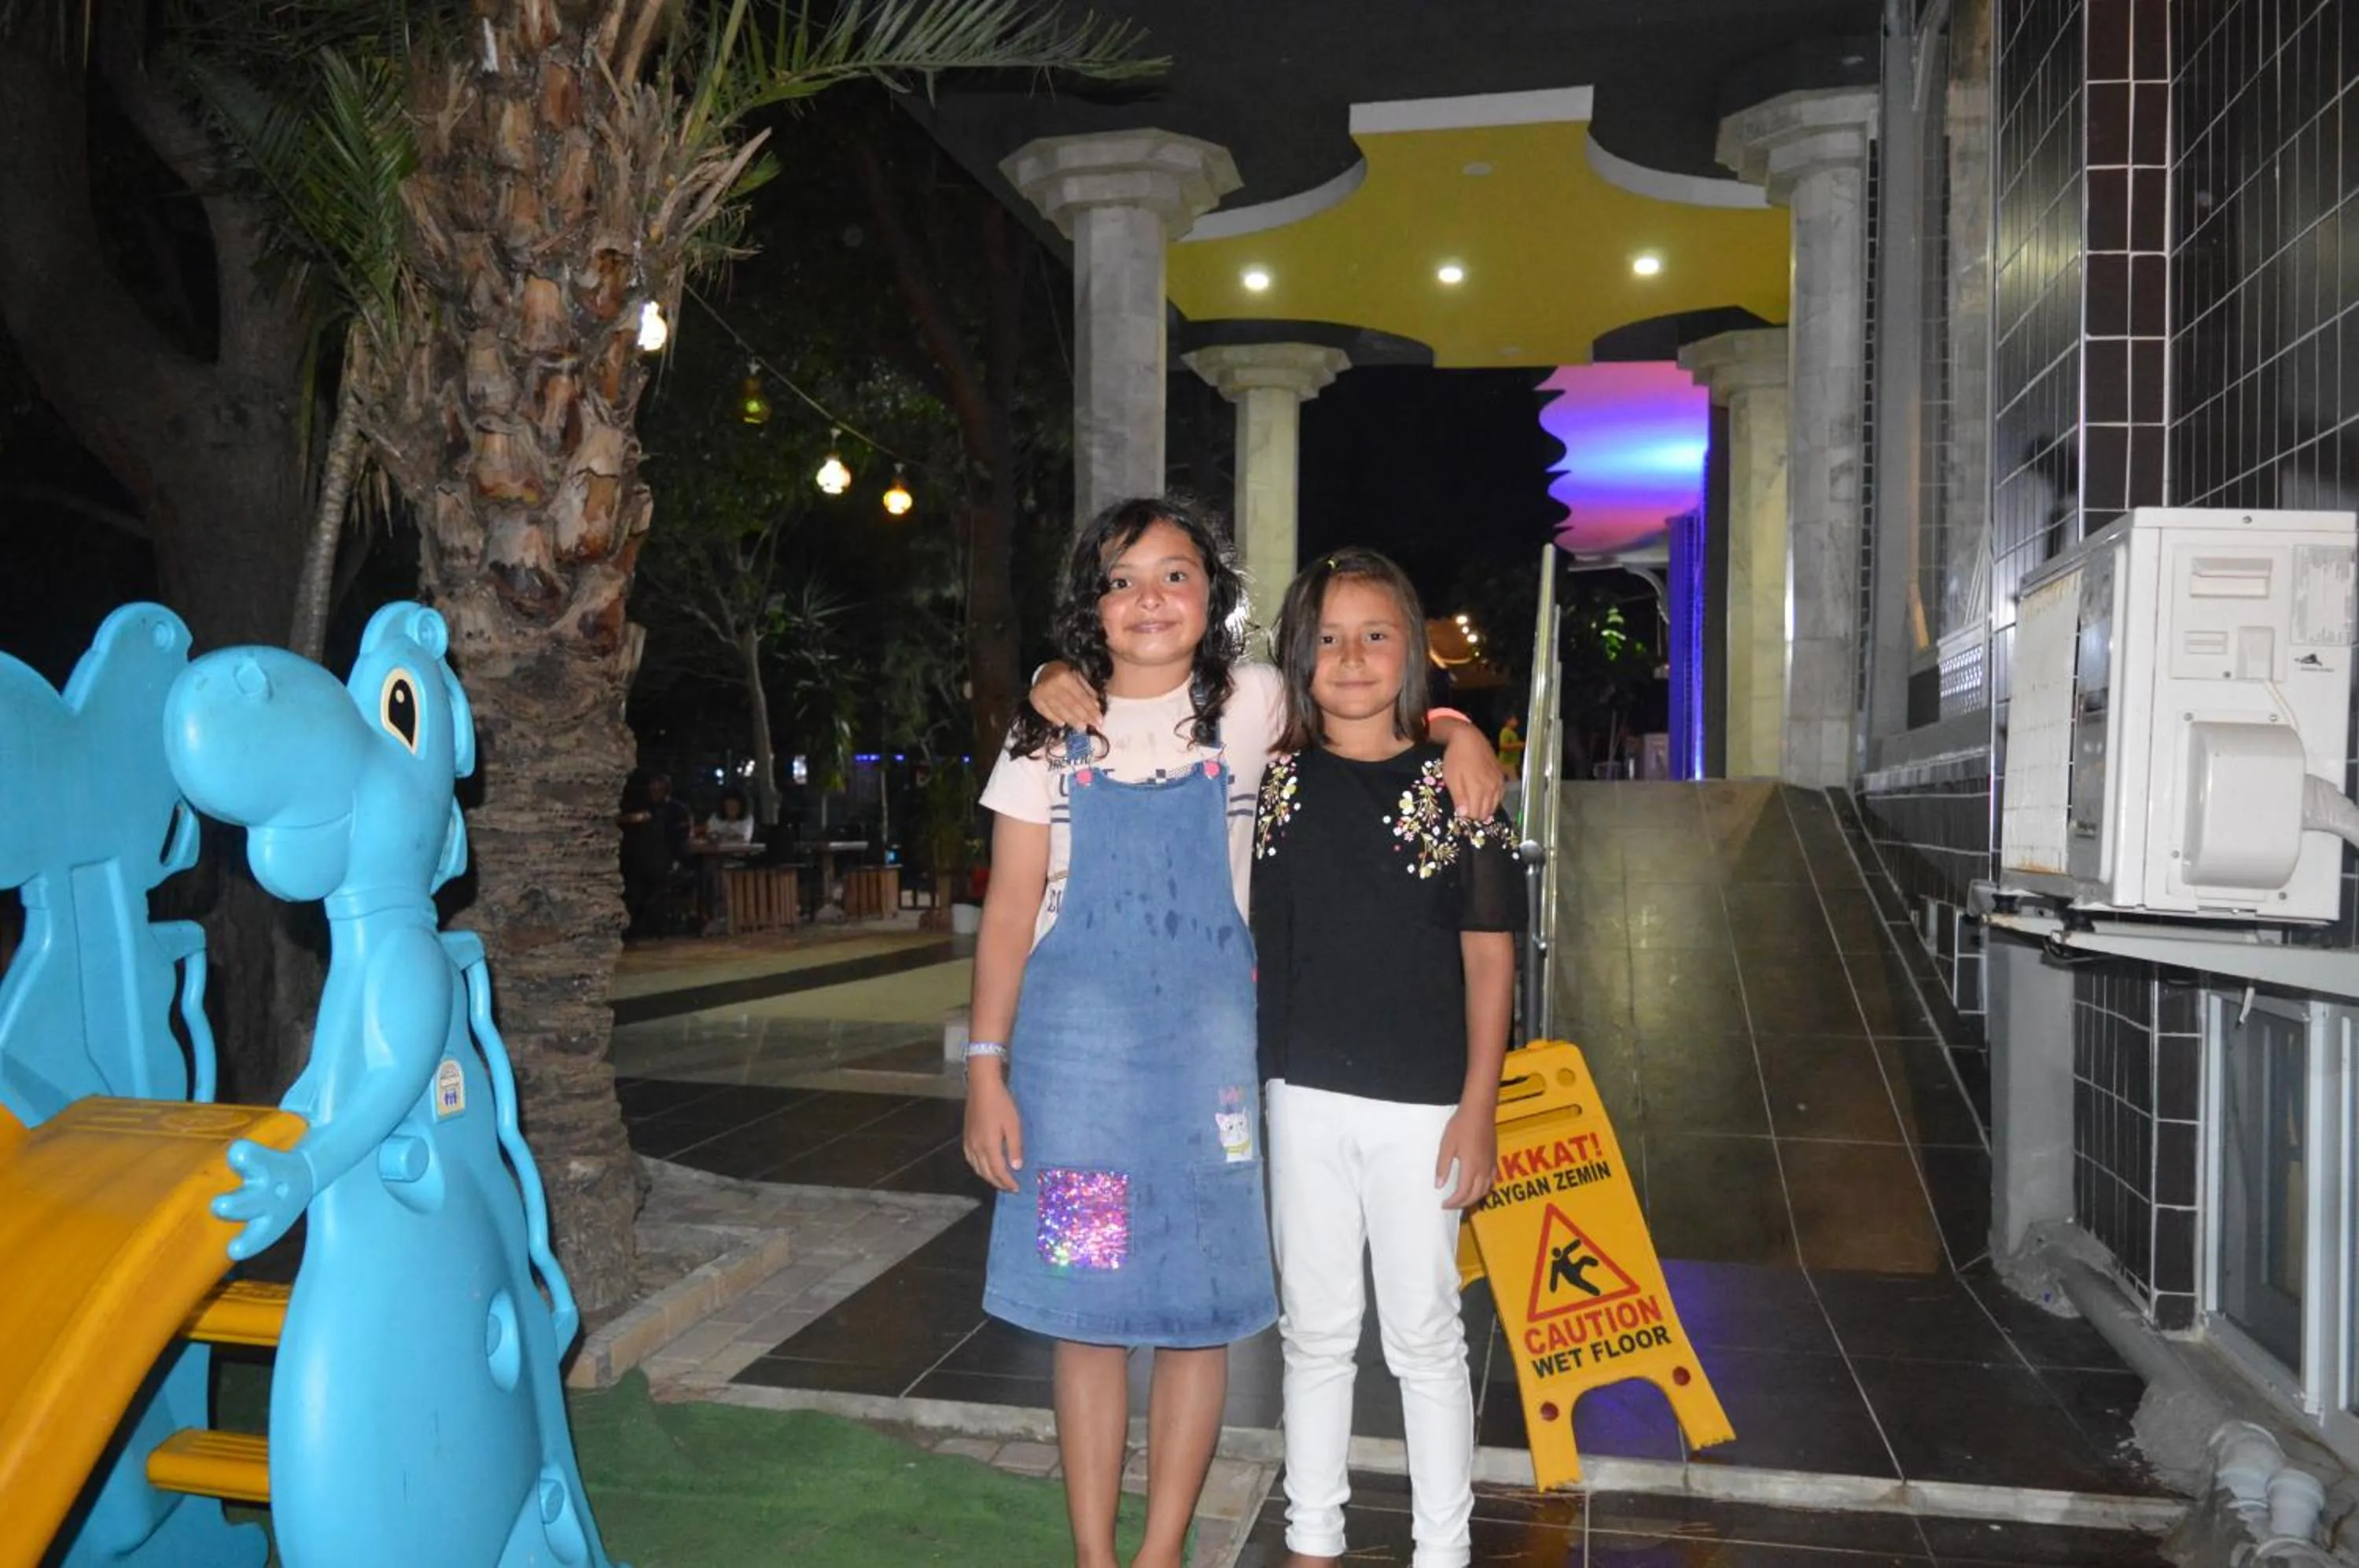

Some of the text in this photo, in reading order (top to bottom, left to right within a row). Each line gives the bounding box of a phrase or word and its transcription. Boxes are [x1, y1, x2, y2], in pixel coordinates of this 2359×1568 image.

[1495, 1132, 1603, 1183] KKAT!
[1553, 1160, 1611, 1191] ZEMİN
[1524, 1295, 1663, 1356] CAUTION
[1532, 1325, 1673, 1378] WET FLOOR
